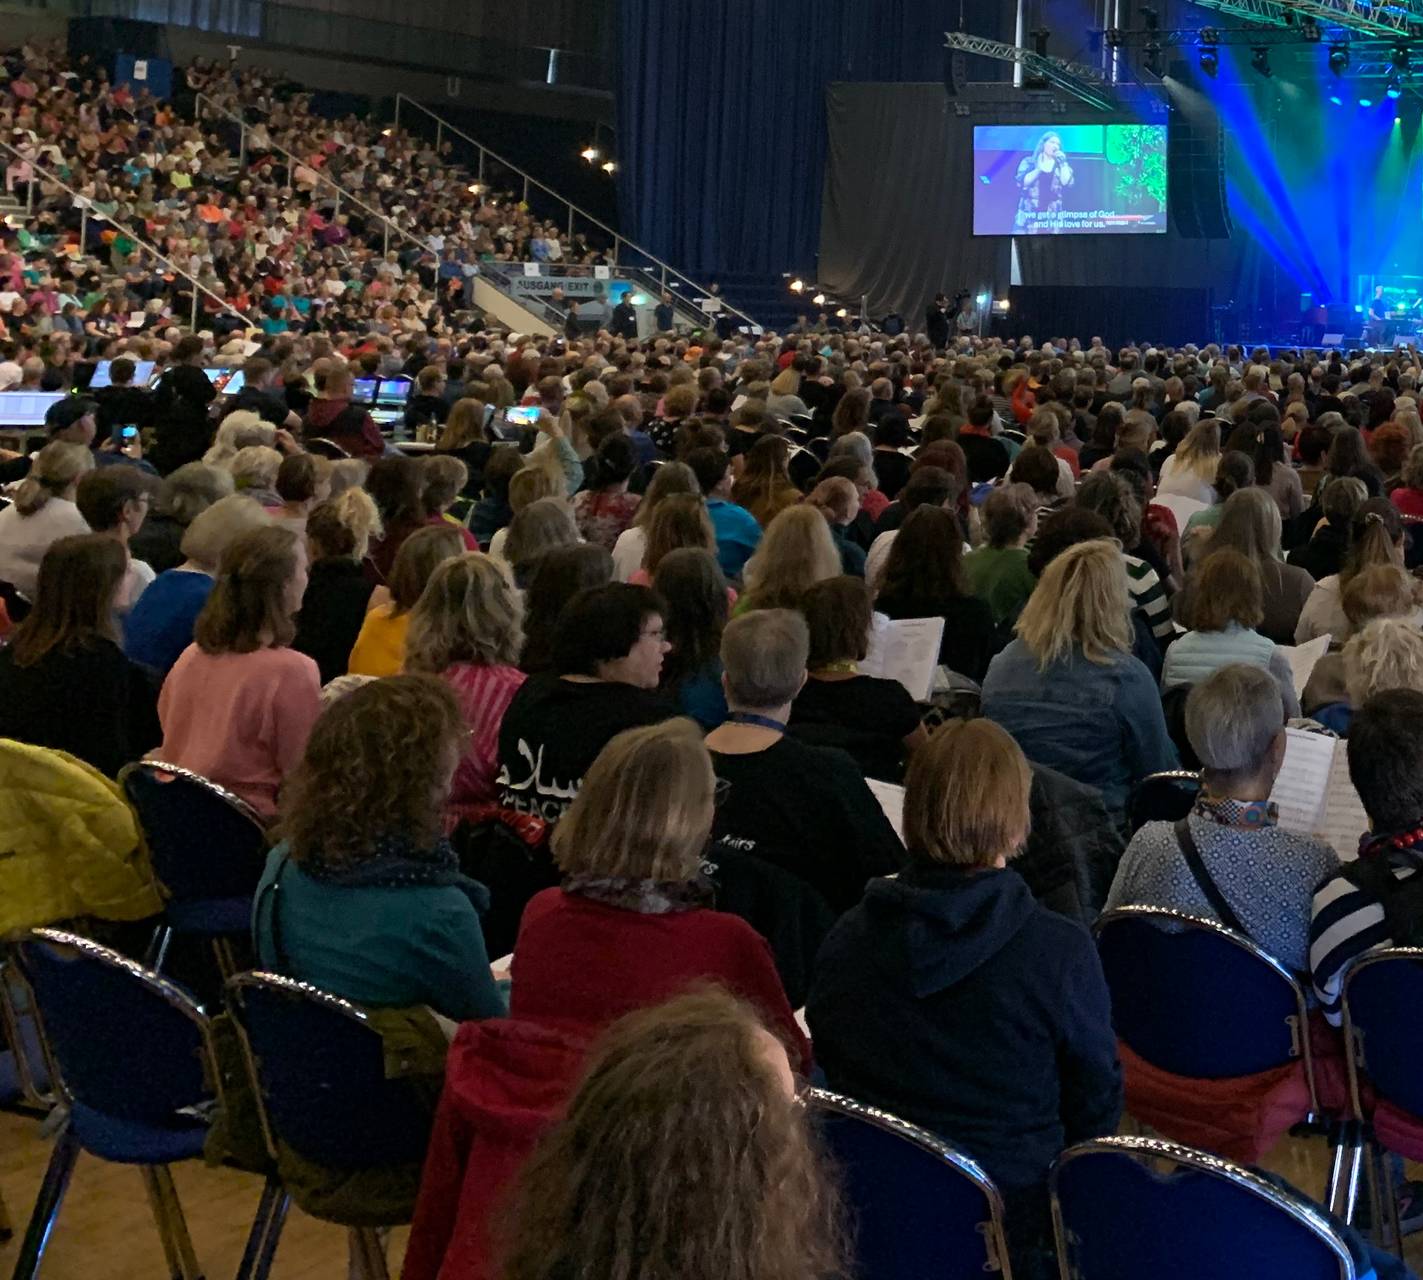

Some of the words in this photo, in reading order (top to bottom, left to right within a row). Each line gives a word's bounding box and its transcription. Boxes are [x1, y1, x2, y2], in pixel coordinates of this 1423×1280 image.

[1037, 211, 1050, 220] get
[1057, 211, 1088, 220] glimpse
[1098, 210, 1115, 218] God
[1081, 220, 1092, 228] for
[567, 282, 590, 291] EXIT
